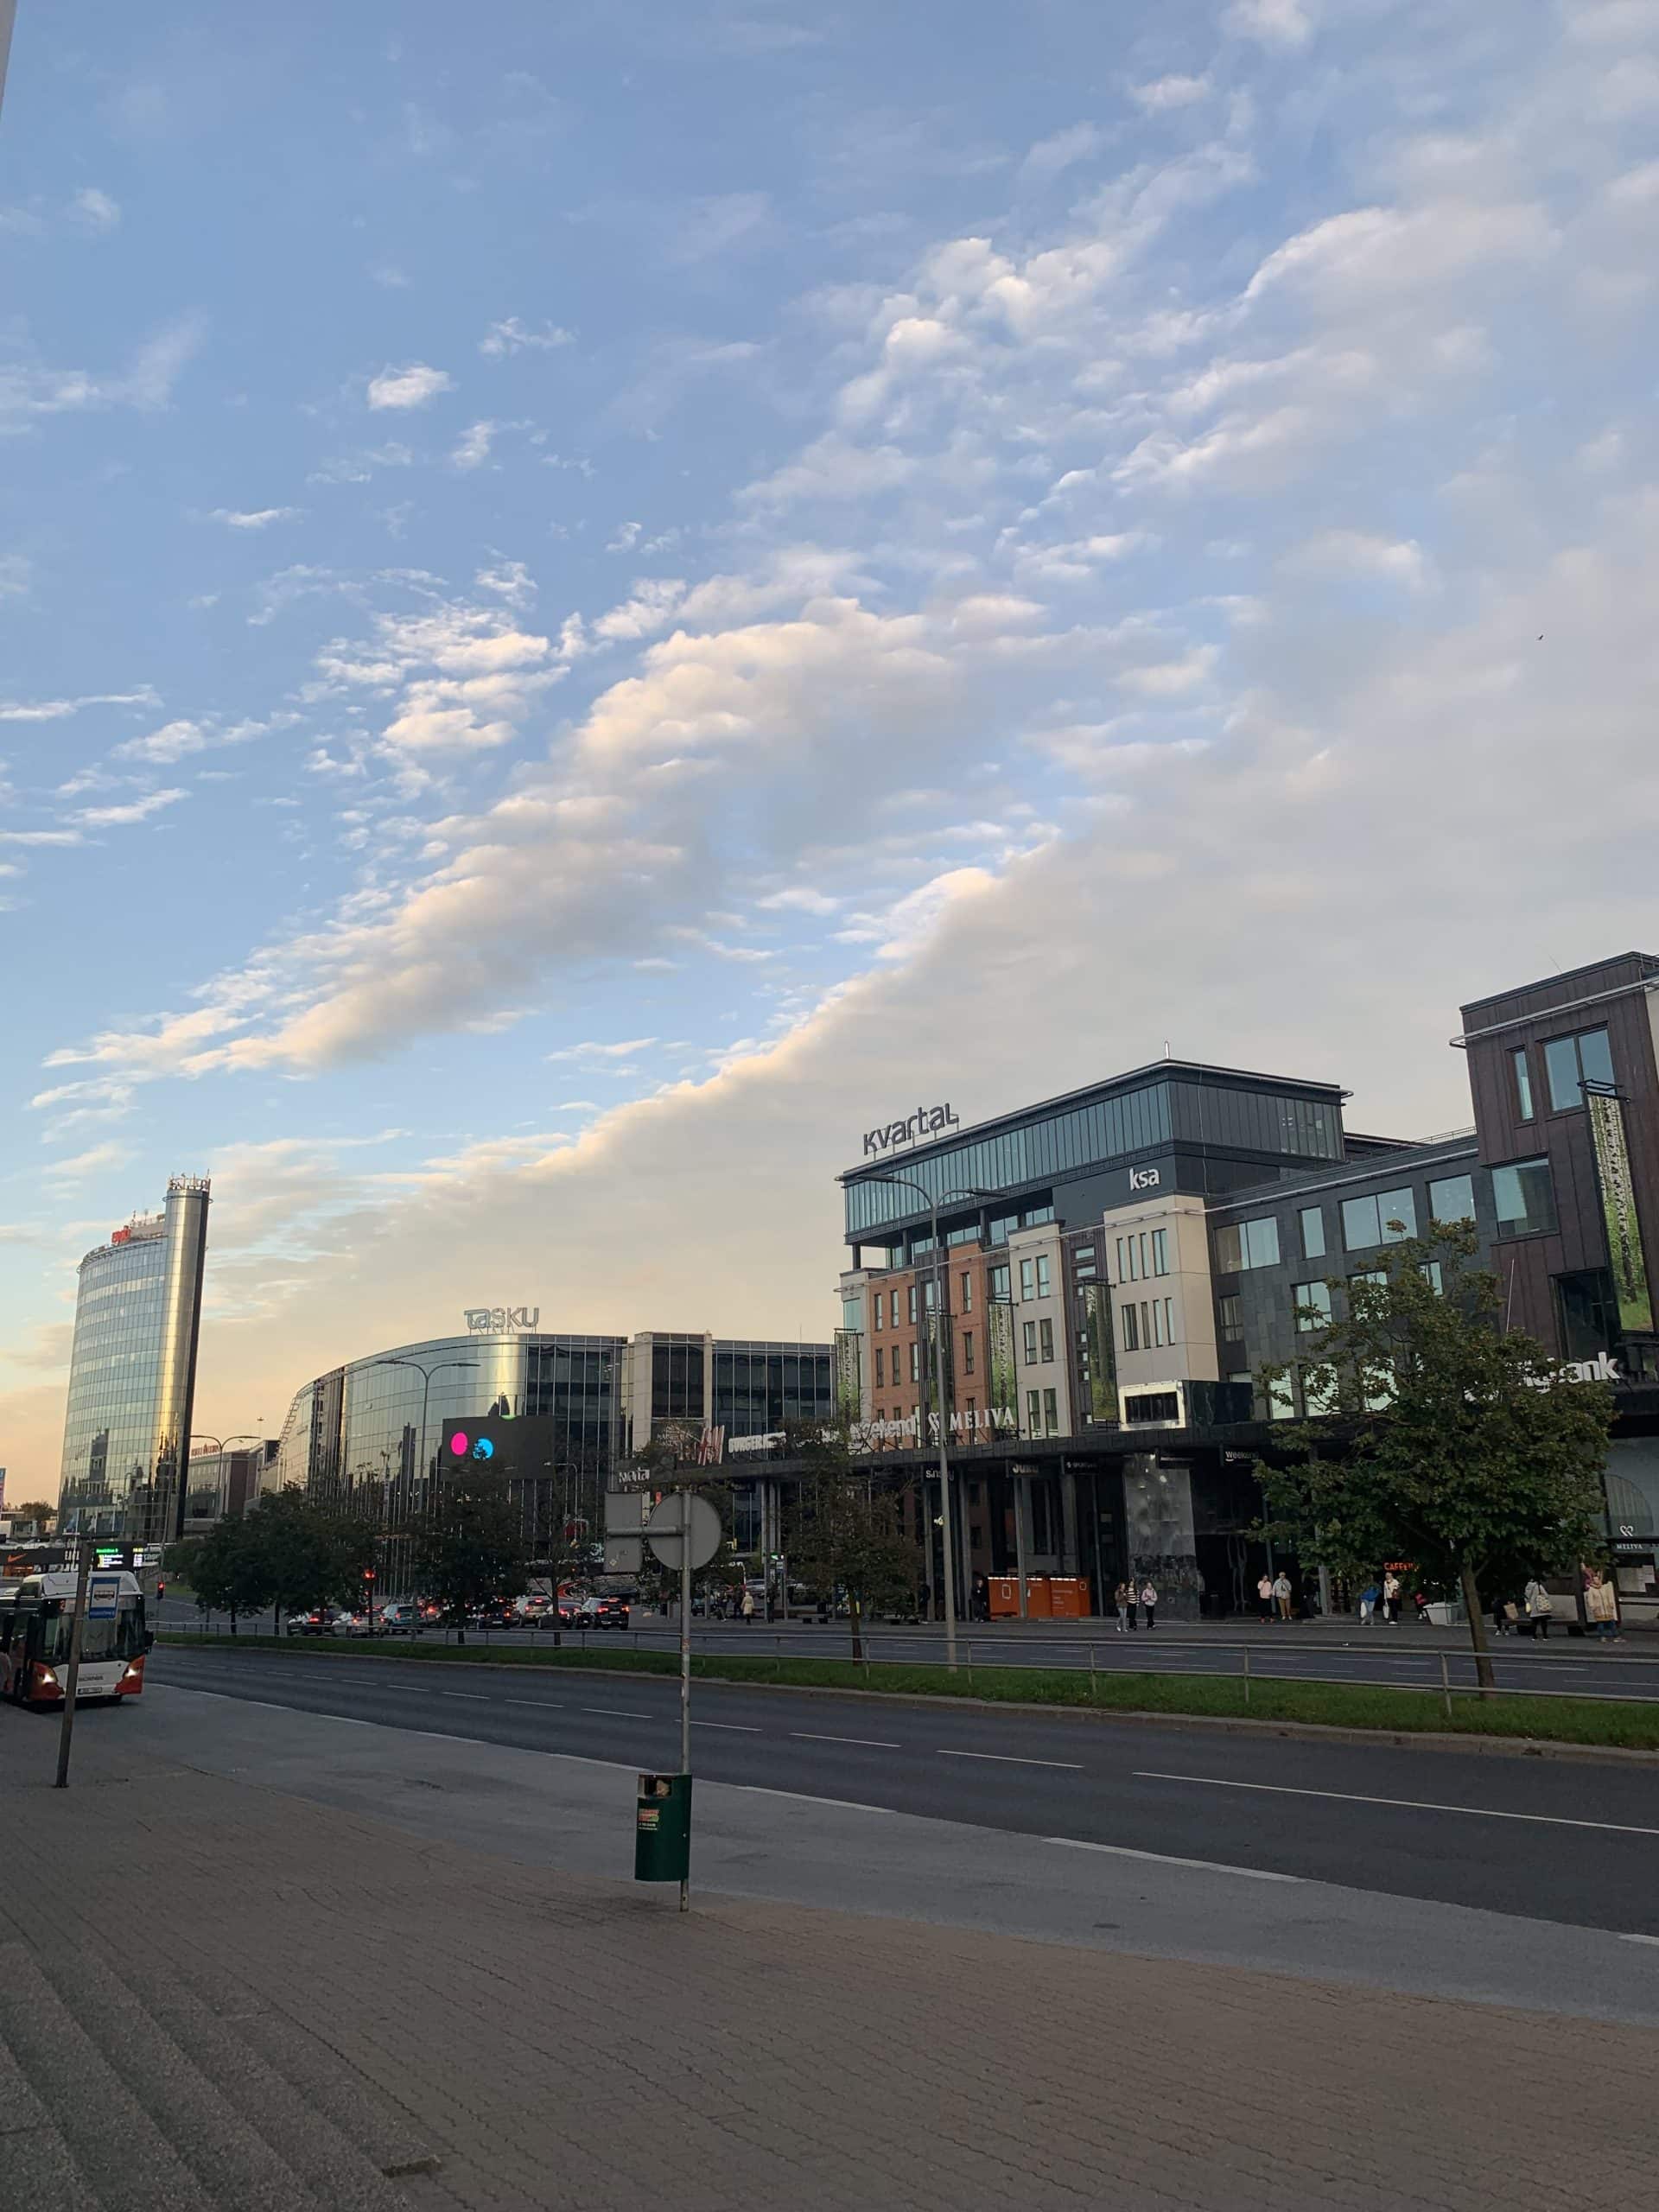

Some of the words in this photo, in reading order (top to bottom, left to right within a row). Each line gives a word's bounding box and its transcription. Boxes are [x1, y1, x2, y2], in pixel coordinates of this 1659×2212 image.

[863, 1103, 959, 1156] Kvartal
[1129, 1167, 1160, 1191] ksa
[950, 1407, 1015, 1432] MELIVA
